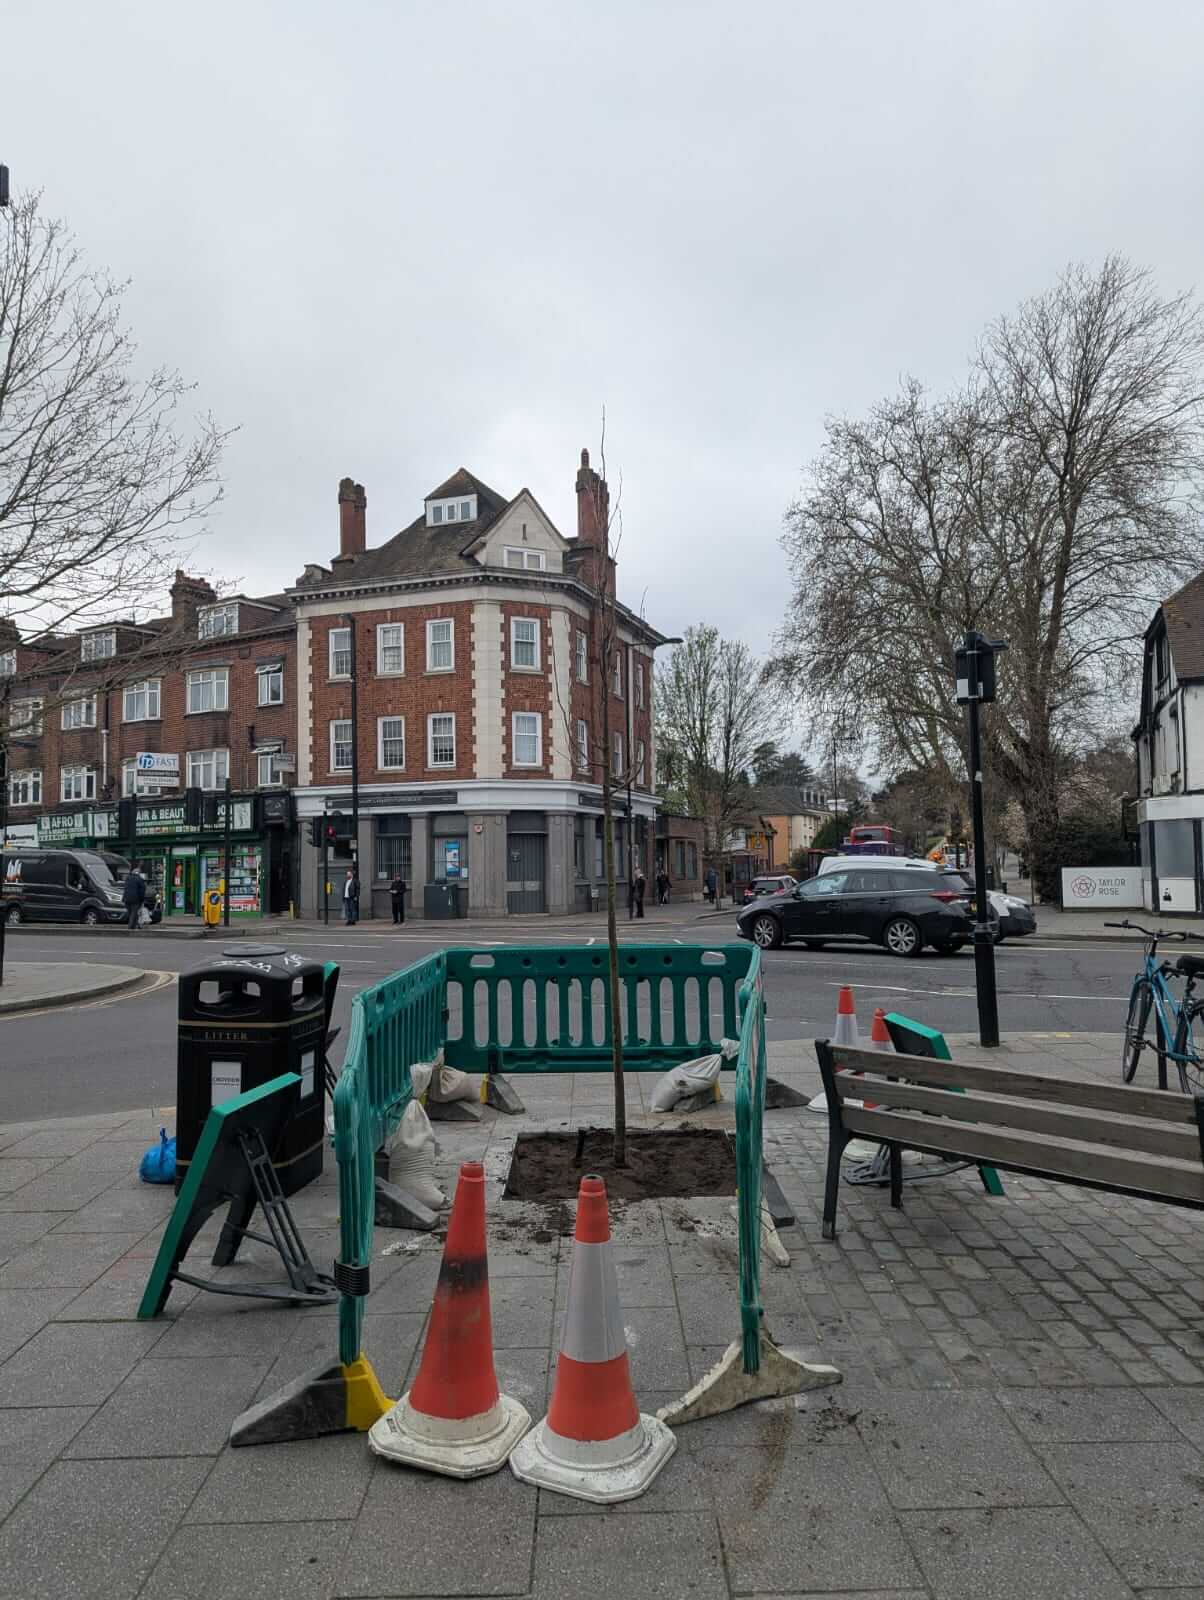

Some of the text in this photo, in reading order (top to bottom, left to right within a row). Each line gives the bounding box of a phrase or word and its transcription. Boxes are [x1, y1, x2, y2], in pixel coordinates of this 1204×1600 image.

[136, 809, 150, 821] AIR
[159, 807, 185, 820] BEAUT
[51, 815, 73, 828] AFRO
[1099, 878, 1126, 887] TAYLOR
[1099, 888, 1120, 896] ROSE
[204, 1031, 248, 1041] LITTER
